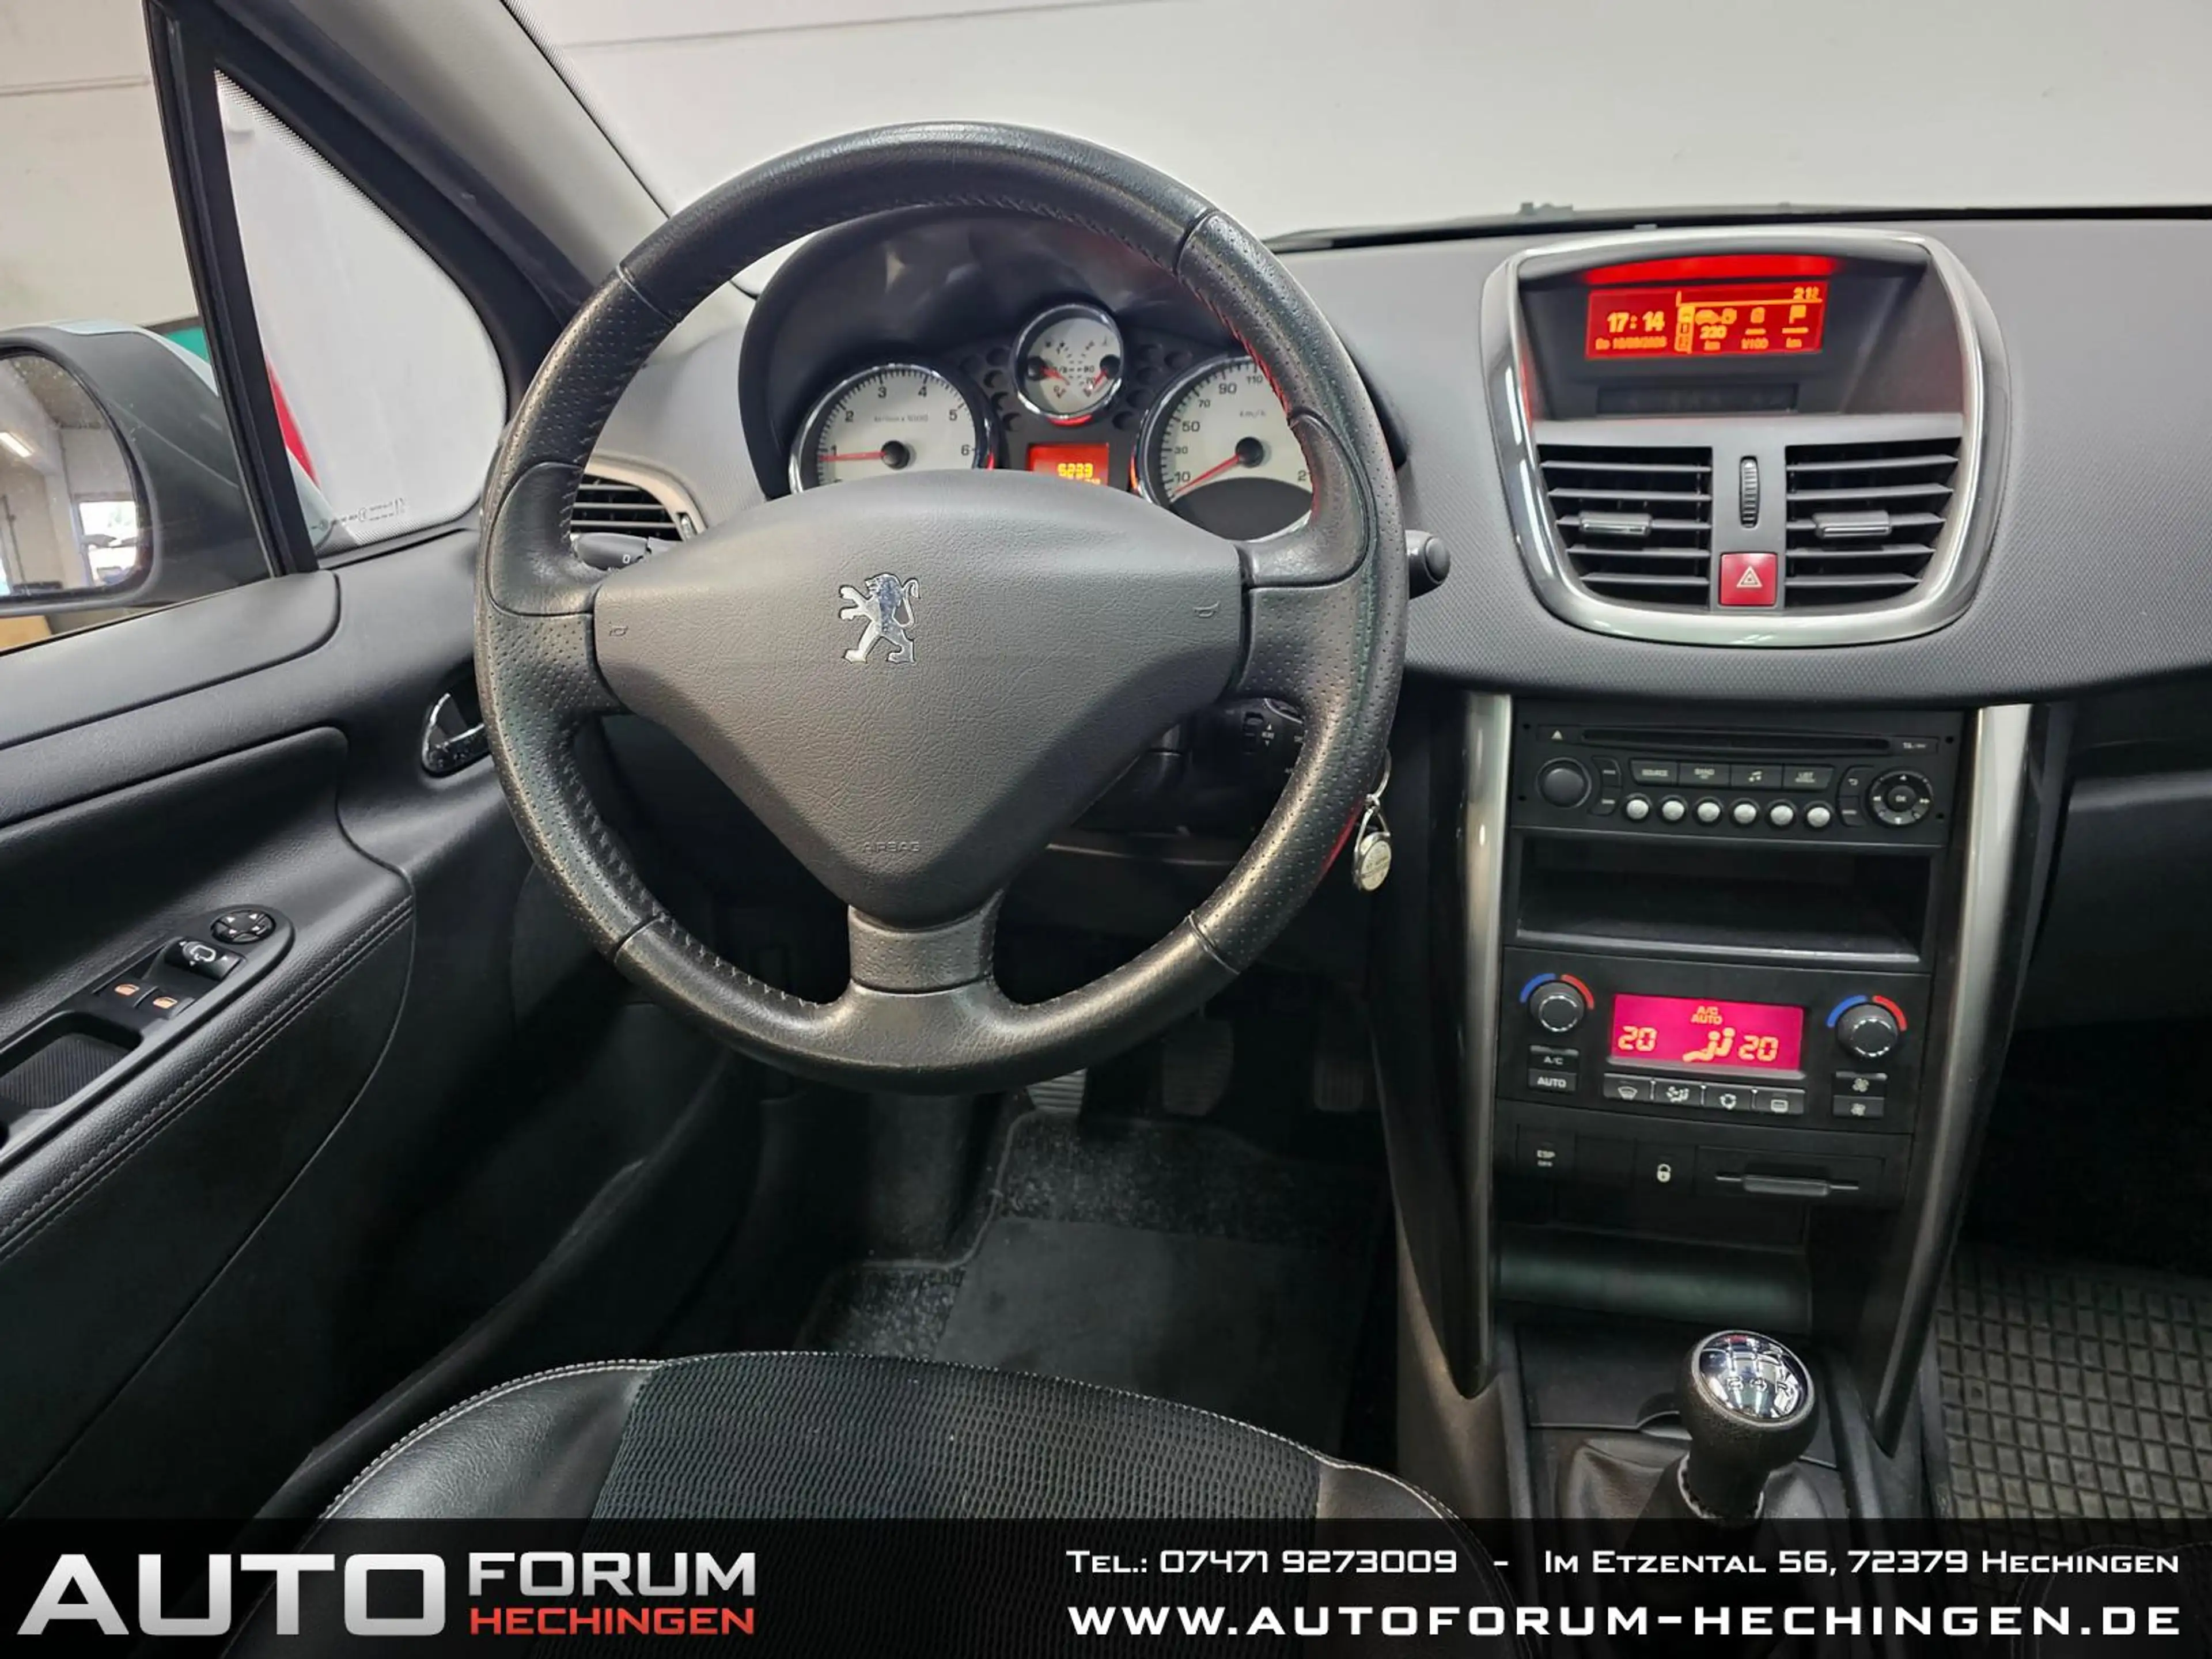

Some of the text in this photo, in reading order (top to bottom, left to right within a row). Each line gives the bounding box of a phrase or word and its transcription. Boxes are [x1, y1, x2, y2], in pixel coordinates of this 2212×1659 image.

[1246, 376, 1263, 384] 110
[878, 387, 887, 397] 3
[918, 386, 927, 397] 4
[1219, 382, 1237, 395] 90
[1198, 399, 1211, 408] 70
[844, 411, 854, 422] 2
[949, 410, 957, 421] 5
[1181, 421, 1200, 433] 50
[961, 444, 970, 456] 6
[1175, 471, 1191, 483] 10
[1690, 1014, 1723, 1024] AUTO
[1618, 1026, 1657, 1052] 20
[1737, 1035, 1779, 1062] 20
[1537, 1077, 1567, 1088] AUTO
